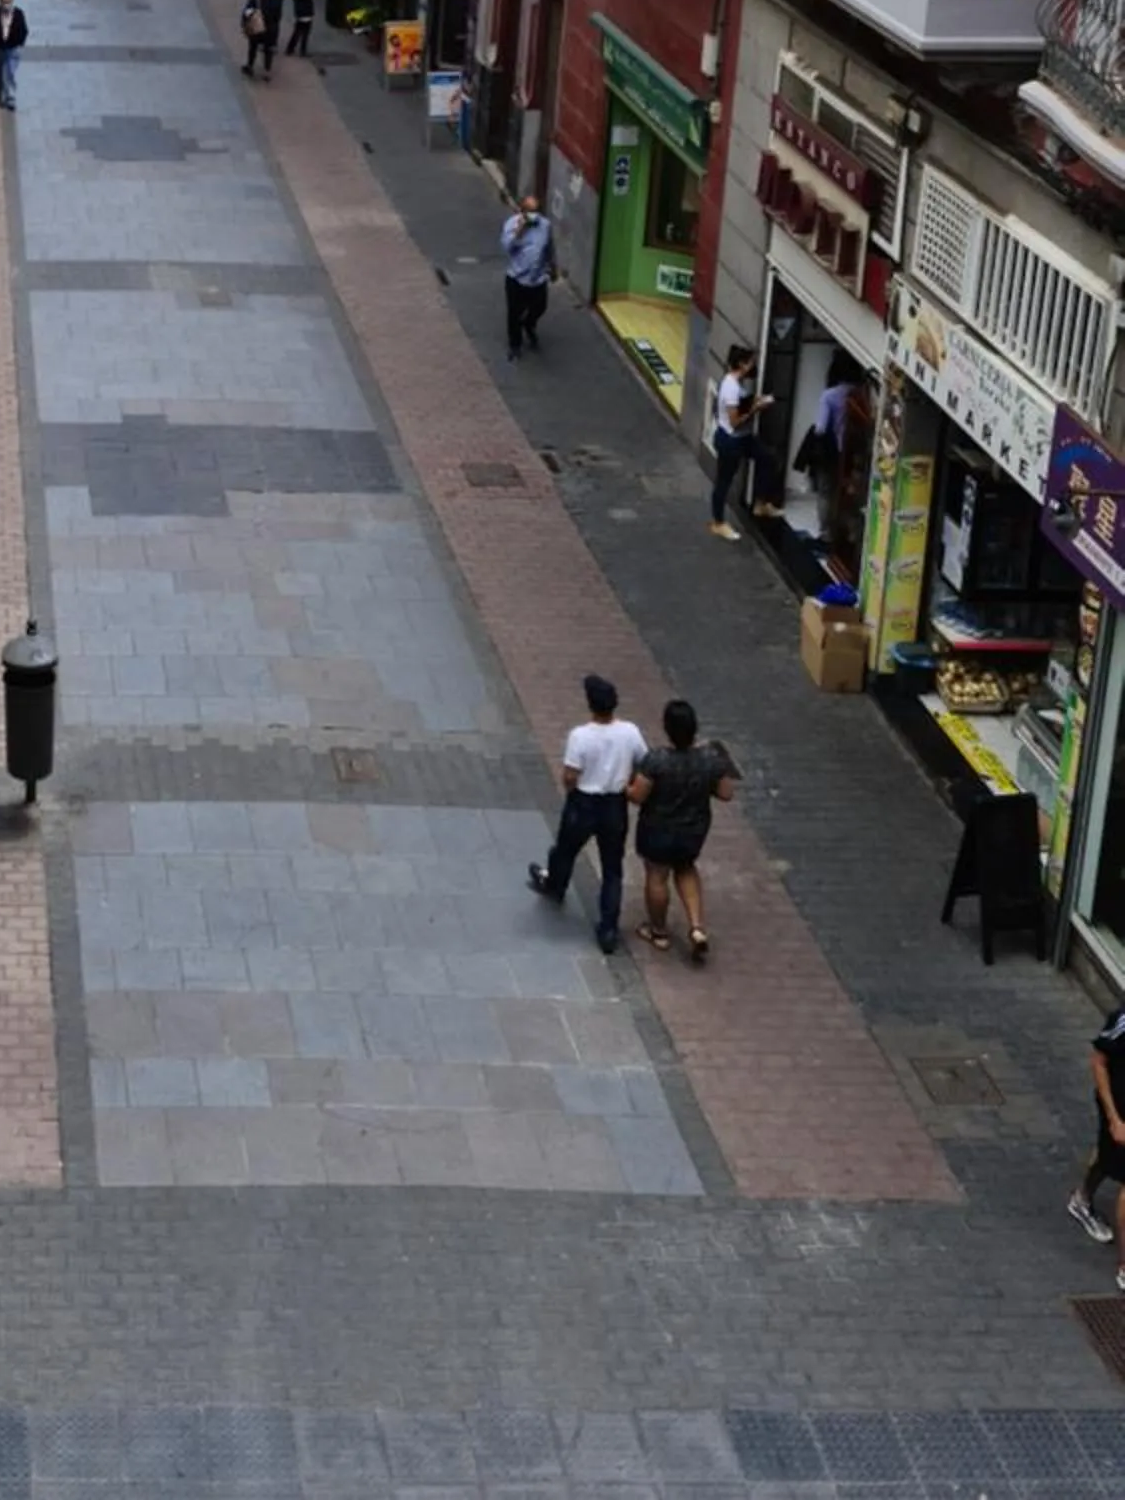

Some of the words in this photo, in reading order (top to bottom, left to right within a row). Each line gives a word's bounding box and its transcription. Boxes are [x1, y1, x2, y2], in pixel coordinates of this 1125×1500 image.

[774, 108, 857, 191] ESTANCO
[887, 333, 938, 395] MINI
[945, 389, 1048, 500] MARKET
